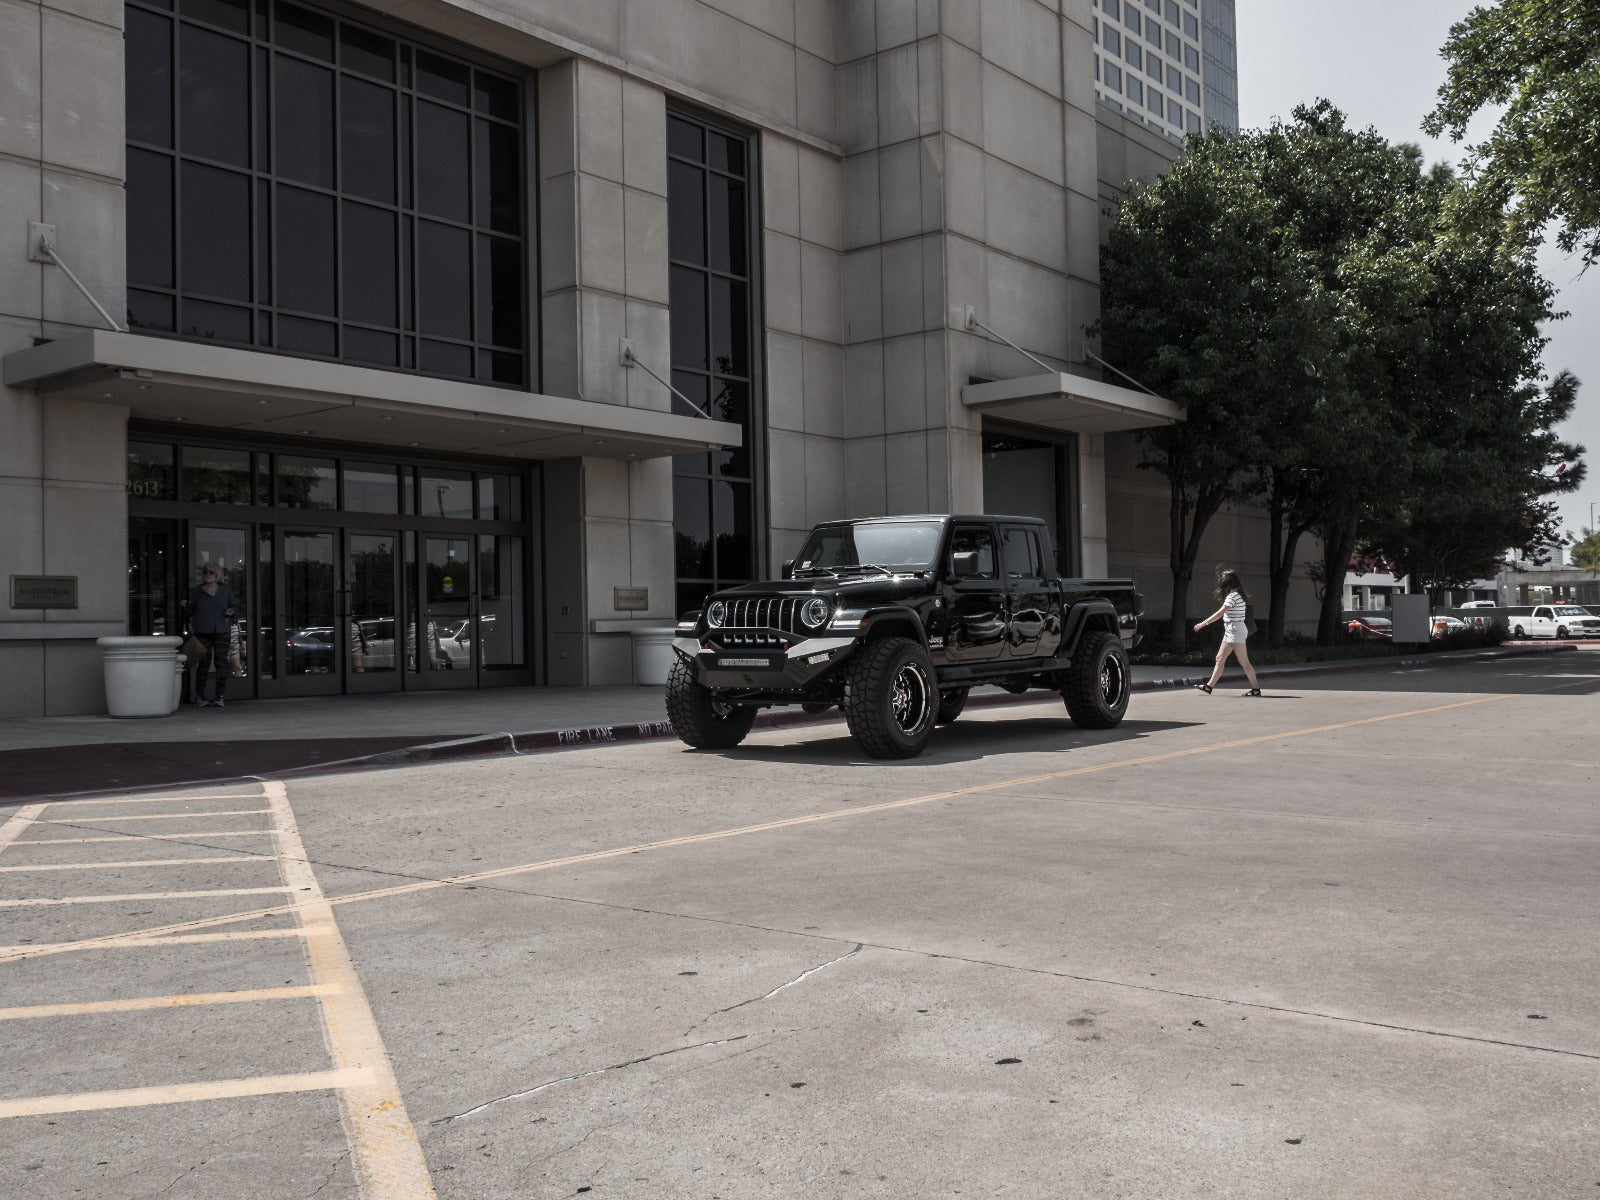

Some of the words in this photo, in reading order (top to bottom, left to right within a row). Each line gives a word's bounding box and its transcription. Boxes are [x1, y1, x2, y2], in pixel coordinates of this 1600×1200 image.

[126, 479, 160, 496] 2613
[558, 730, 583, 746] FIRE
[587, 727, 616, 744] LANE
